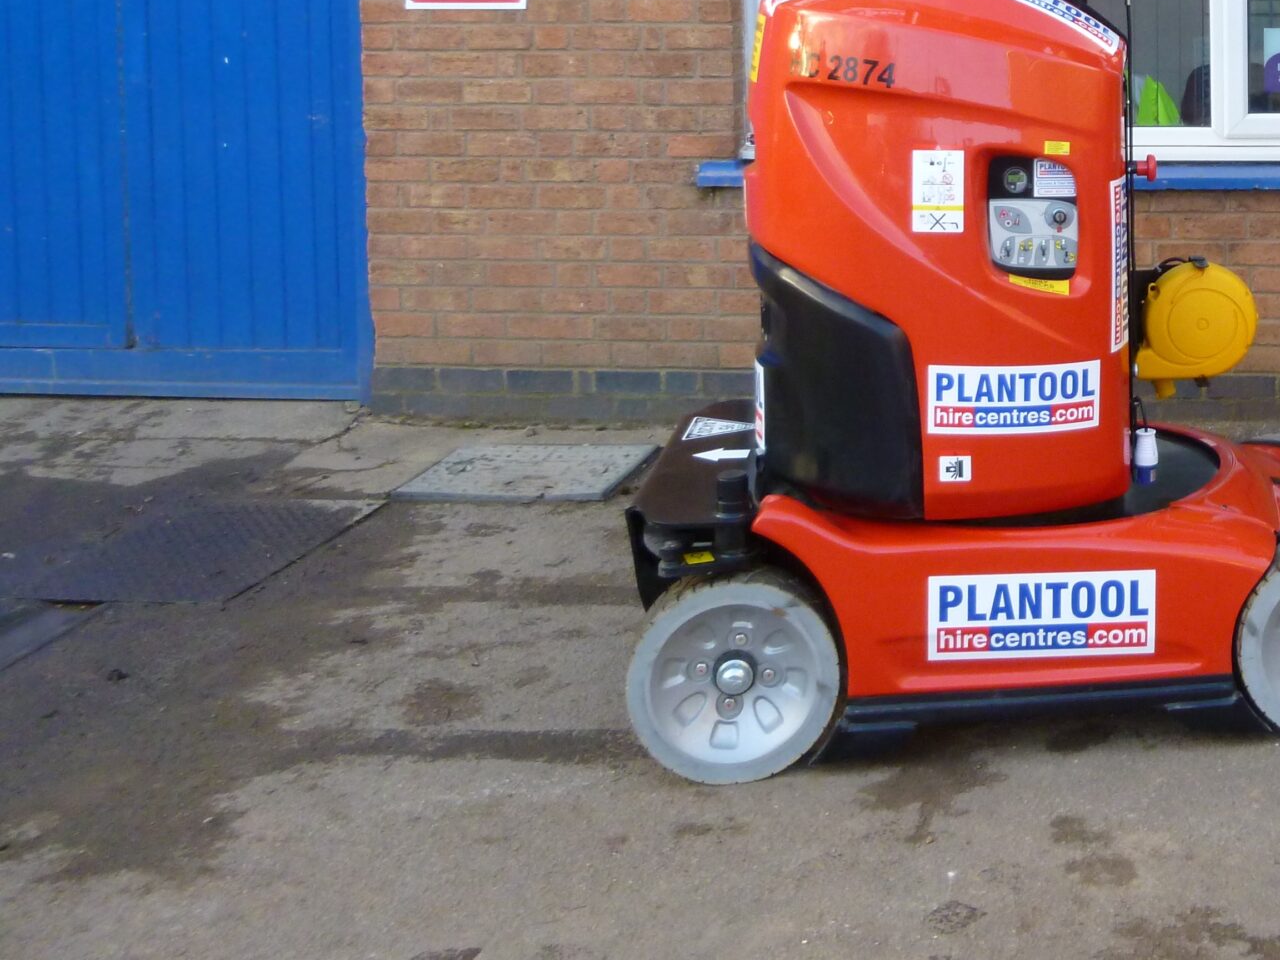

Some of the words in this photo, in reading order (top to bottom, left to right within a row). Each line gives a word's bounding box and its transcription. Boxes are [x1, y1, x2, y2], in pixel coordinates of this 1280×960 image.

[827, 55, 896, 89] 2874
[1114, 187, 1122, 343] hirecentres.com
[935, 368, 1096, 403] PLANTOOL
[935, 404, 1094, 426] hirecentres.com
[938, 579, 1149, 623] PLANTOOL
[938, 626, 1147, 650] hirecentres.com
